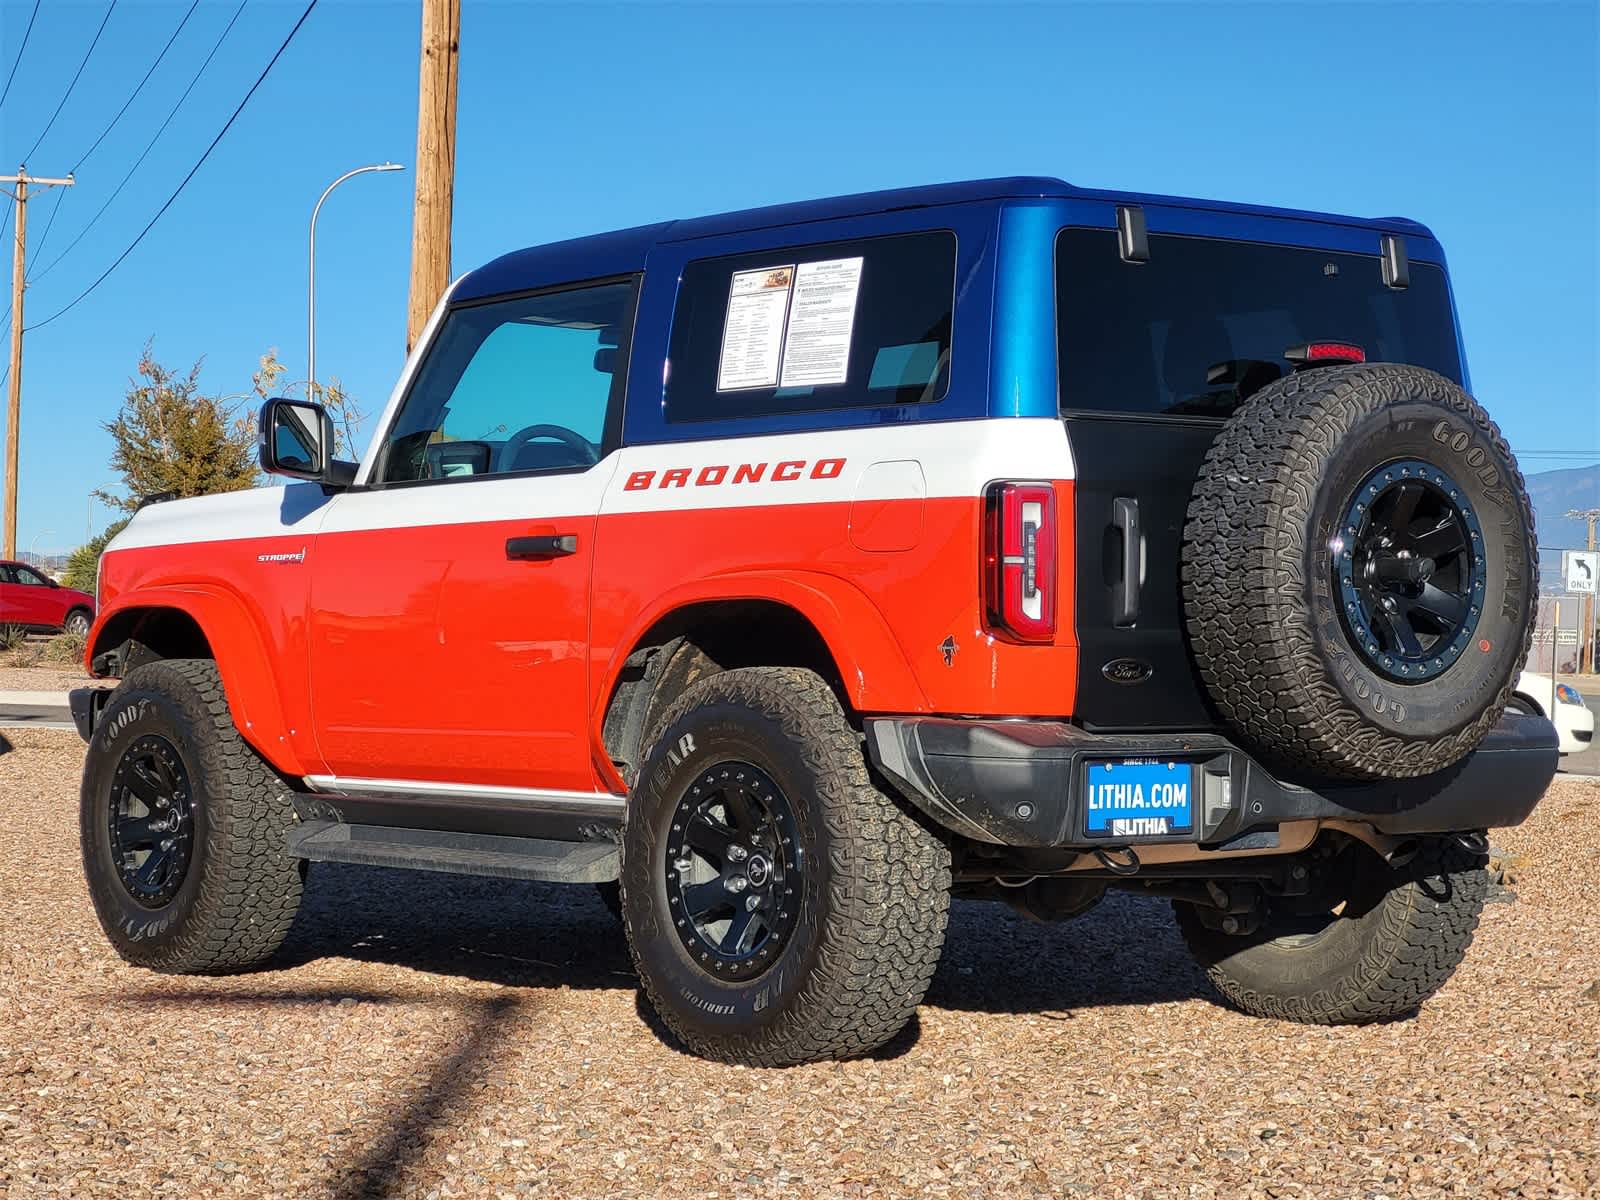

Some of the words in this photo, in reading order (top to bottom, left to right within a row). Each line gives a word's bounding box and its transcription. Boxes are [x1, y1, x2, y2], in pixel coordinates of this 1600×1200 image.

[623, 458, 847, 491] BRONCO
[1432, 419, 1523, 626] GOODYEAR
[257, 553, 304, 562] STROPPE
[1570, 580, 1593, 590] ONLY
[1113, 663, 1141, 679] Ford
[1088, 783, 1187, 809] LITHIA.COM
[1125, 817, 1168, 835] LITHIA
